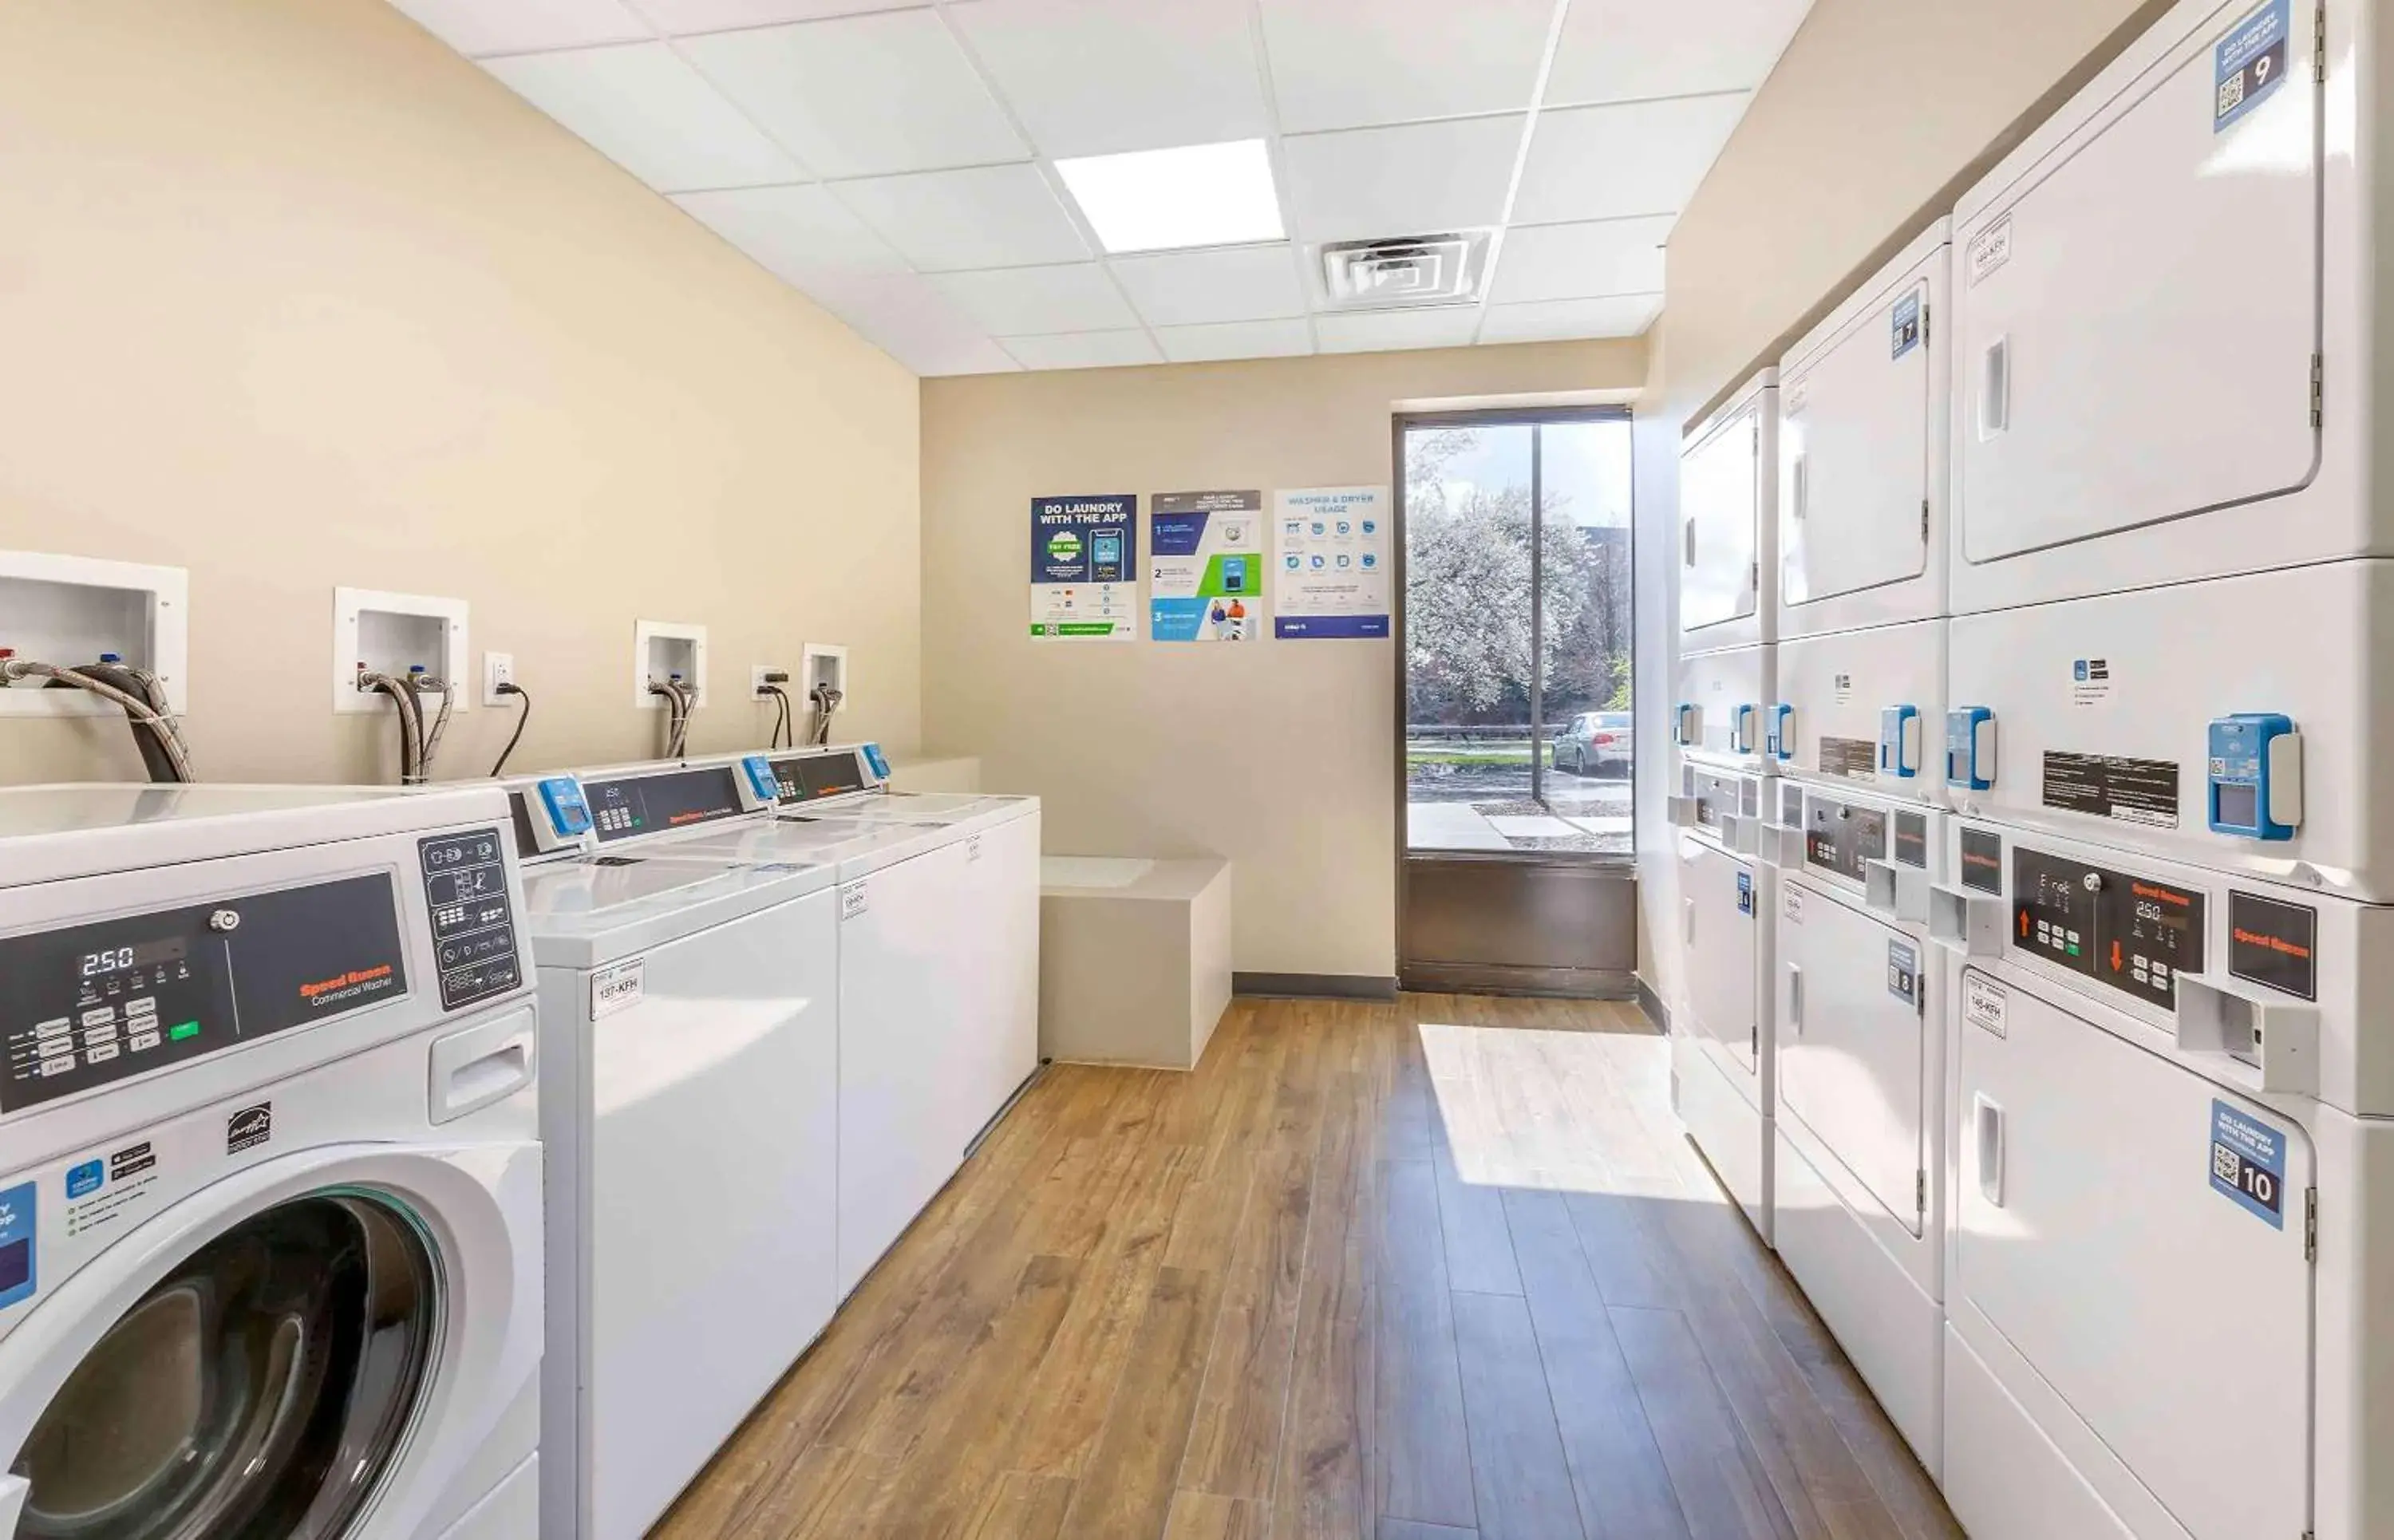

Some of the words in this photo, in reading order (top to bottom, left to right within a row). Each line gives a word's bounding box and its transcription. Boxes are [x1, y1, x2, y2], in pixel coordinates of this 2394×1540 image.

[2222, 48, 2243, 66] WITH
[2245, 33, 2259, 50] THE
[2262, 19, 2278, 37] APP
[2255, 55, 2271, 85] 9
[1045, 505, 1062, 515] DO
[1065, 502, 1124, 513] LAUNDRY
[1341, 494, 1374, 503] DRYER
[1040, 515, 1072, 524] WITH
[1075, 514, 1100, 523] THE
[1103, 513, 1128, 523] APP
[1156, 526, 1161, 535] 1
[1155, 568, 1162, 578] 2
[1155, 612, 1162, 622] 3
[2234, 927, 2270, 947] Speed
[84, 947, 133, 976] 2.50
[299, 973, 347, 997] Speed
[348, 964, 393, 983] Queen
[312, 985, 361, 1006] Commercial
[362, 977, 392, 991] Washer
[1902, 974, 1910, 991] 8
[2218, 1120, 2239, 1137] WITH
[2241, 1131, 2256, 1147] THE
[2234, 1119, 2272, 1145] LAUNDRY
[2245, 1167, 2272, 1201] 10
